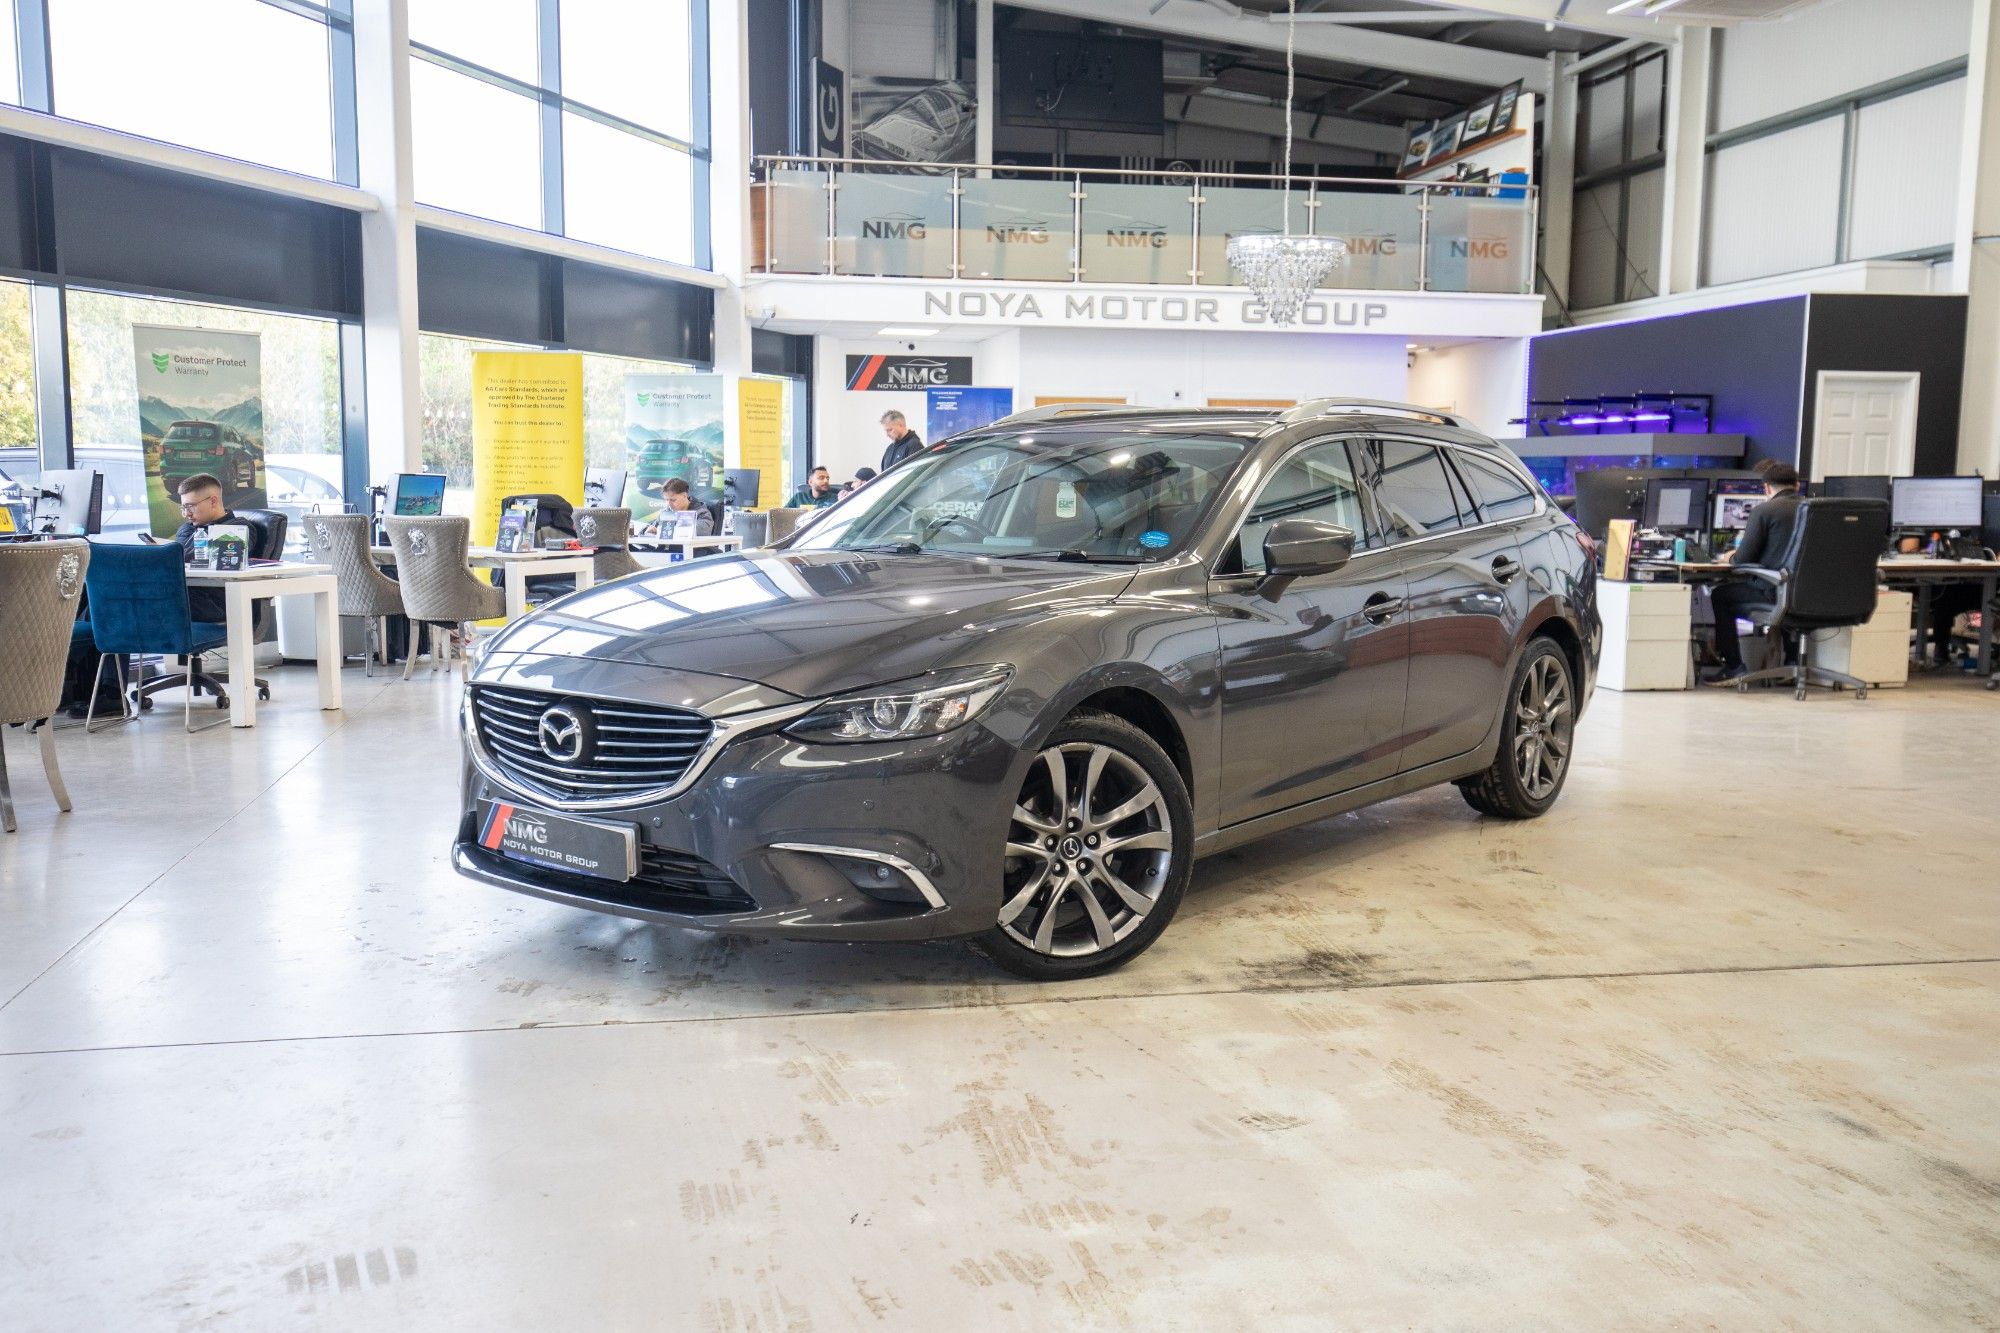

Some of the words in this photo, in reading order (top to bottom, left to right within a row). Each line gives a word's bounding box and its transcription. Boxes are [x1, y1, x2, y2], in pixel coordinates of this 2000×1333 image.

[863, 220, 926, 241] NMG
[986, 225, 1049, 244] NMG
[1107, 229, 1168, 248] NMG
[1450, 240, 1508, 259] NMG
[925, 291, 1043, 318] NOYA
[1066, 295, 1218, 323] MOTOR
[174, 355, 214, 366] Customer
[216, 358, 247, 367] Protect
[175, 367, 209, 376] Warranty
[887, 366, 949, 384] NMG
[503, 817, 548, 844] NMG
[503, 838, 528, 851] NOYA
[530, 845, 563, 861] MOTOR
[566, 854, 599, 869] GROUP
